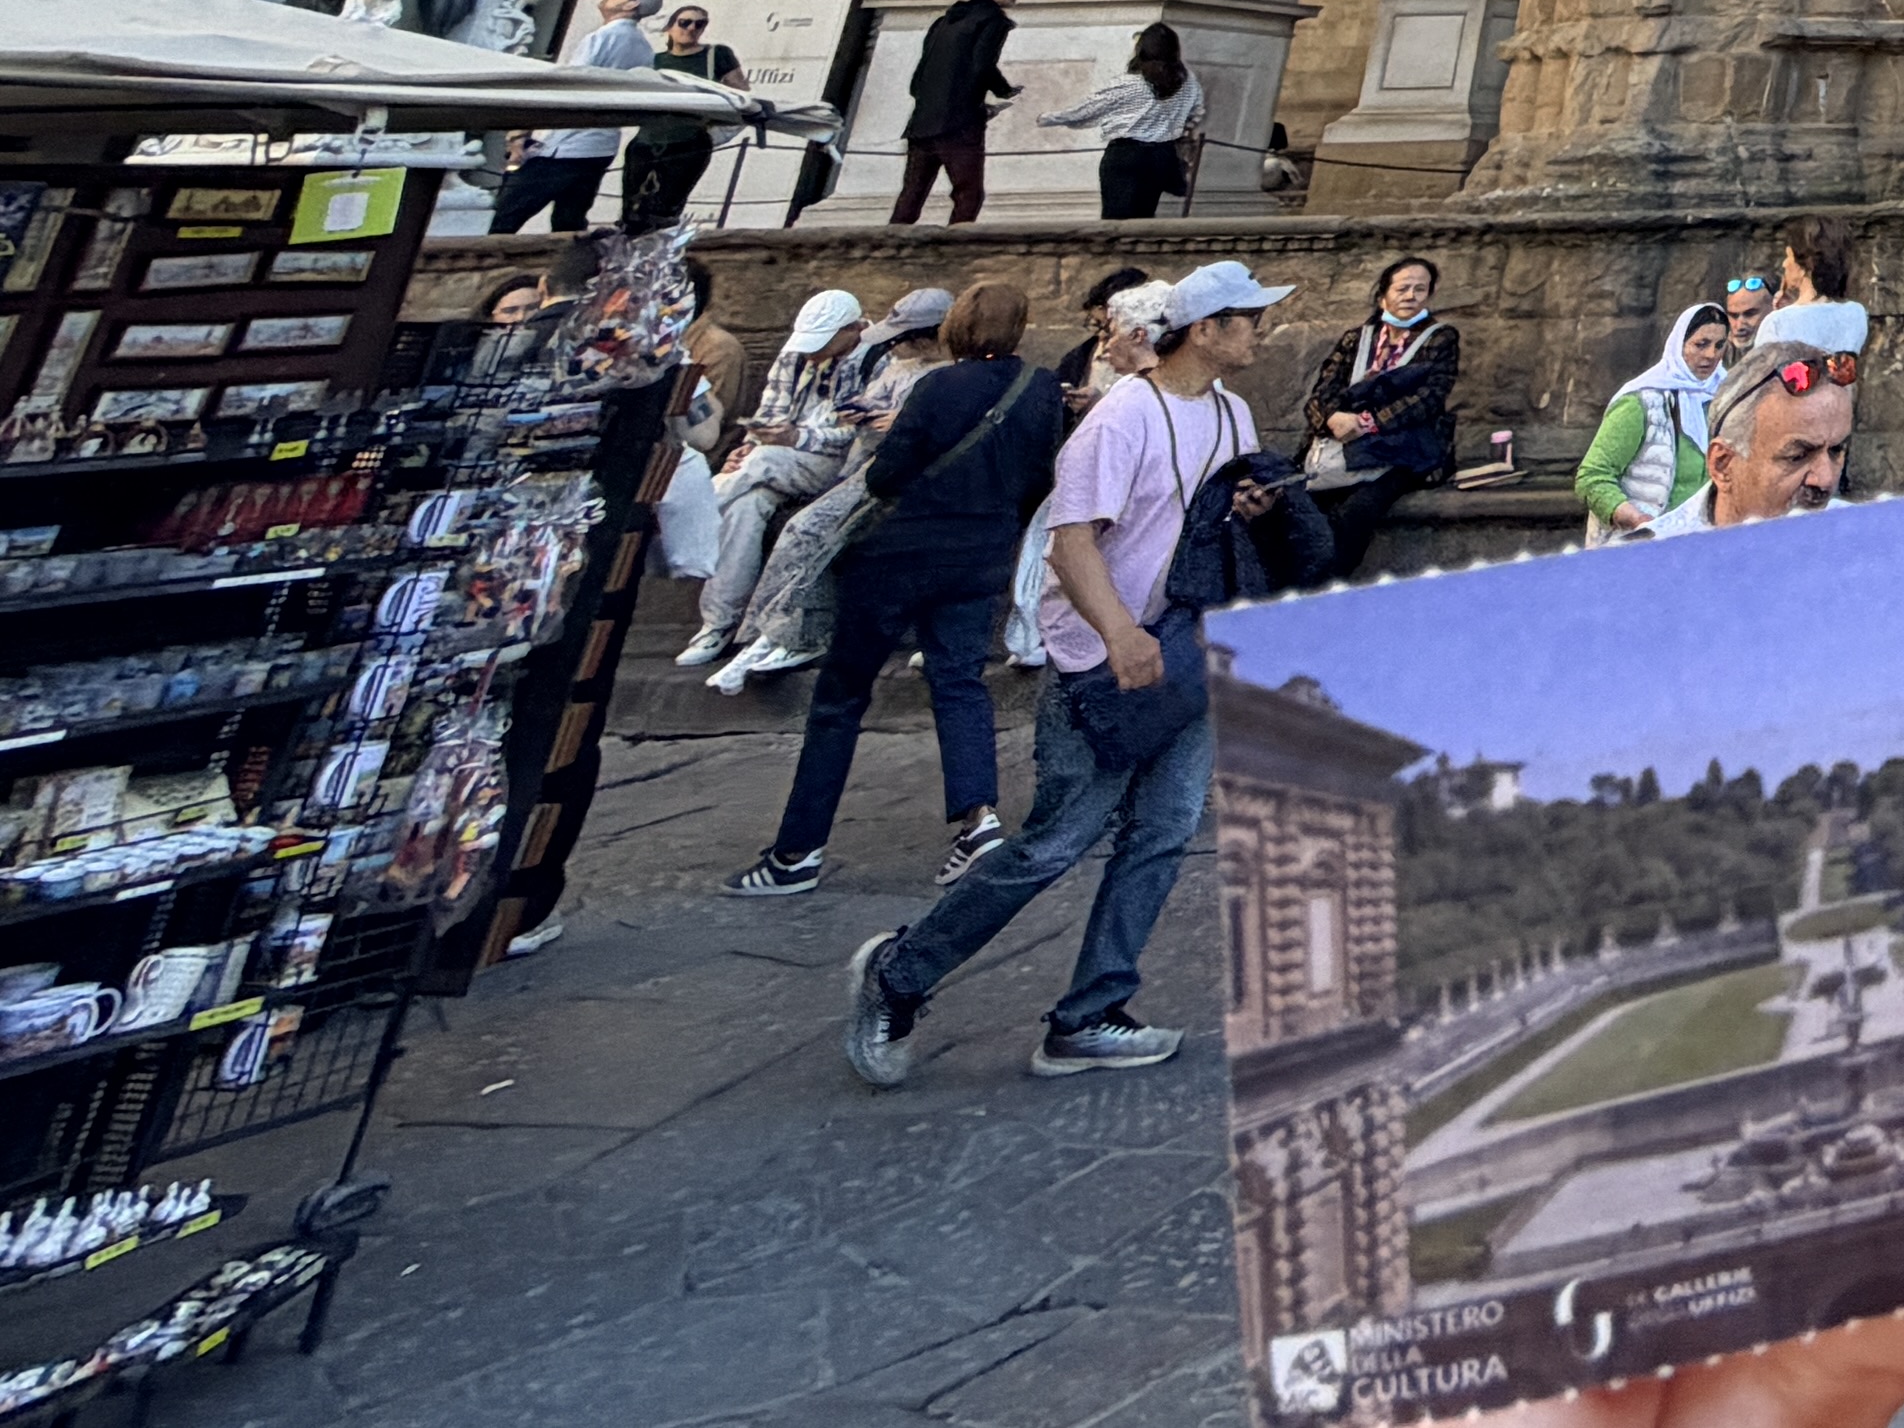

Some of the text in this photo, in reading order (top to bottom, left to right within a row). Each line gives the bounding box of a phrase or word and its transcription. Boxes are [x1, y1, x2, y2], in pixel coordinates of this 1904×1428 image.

[747, 67, 796, 85] Uffizi
[1350, 1300, 1505, 1346] MINISTERO
[1351, 1354, 1509, 1402] CULTURA
